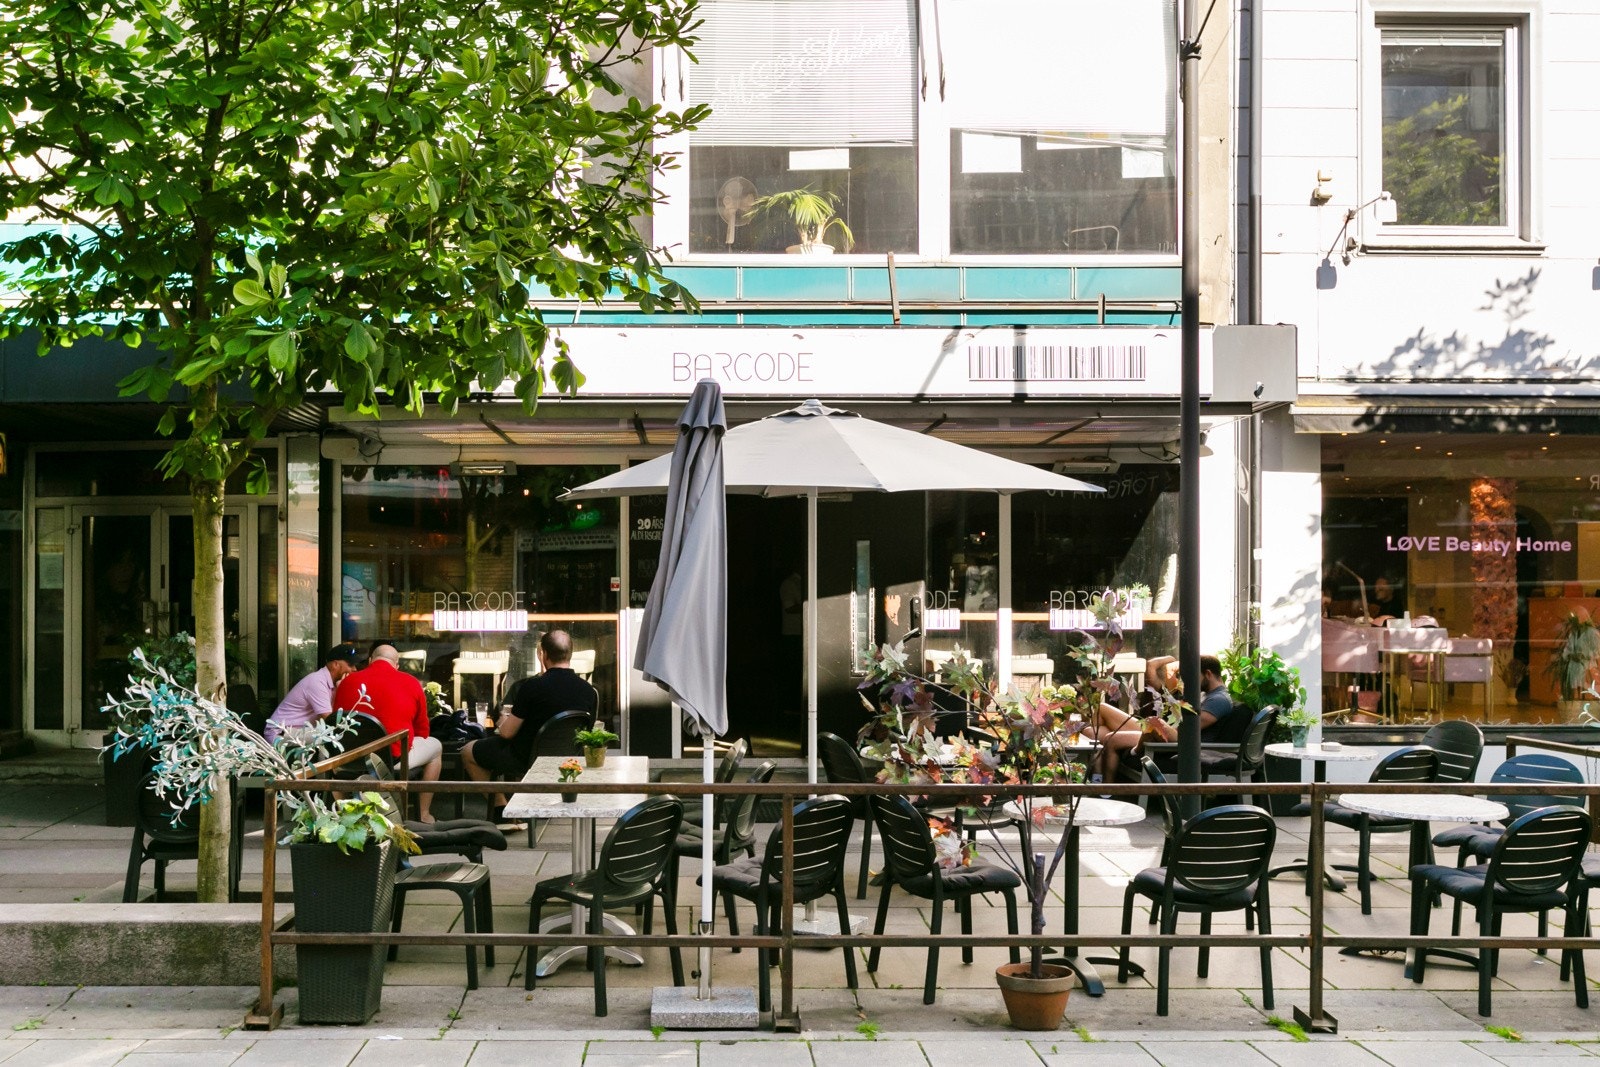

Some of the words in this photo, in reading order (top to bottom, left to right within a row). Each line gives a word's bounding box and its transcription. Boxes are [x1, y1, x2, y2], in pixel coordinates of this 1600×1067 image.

[673, 352, 813, 382] BARCODE
[637, 518, 651, 530] 20
[1386, 535, 1440, 552] LØVE
[1446, 536, 1510, 557] Beauty
[1516, 537, 1572, 552] Home
[434, 591, 526, 611] BARCODE
[925, 590, 959, 610] ODE
